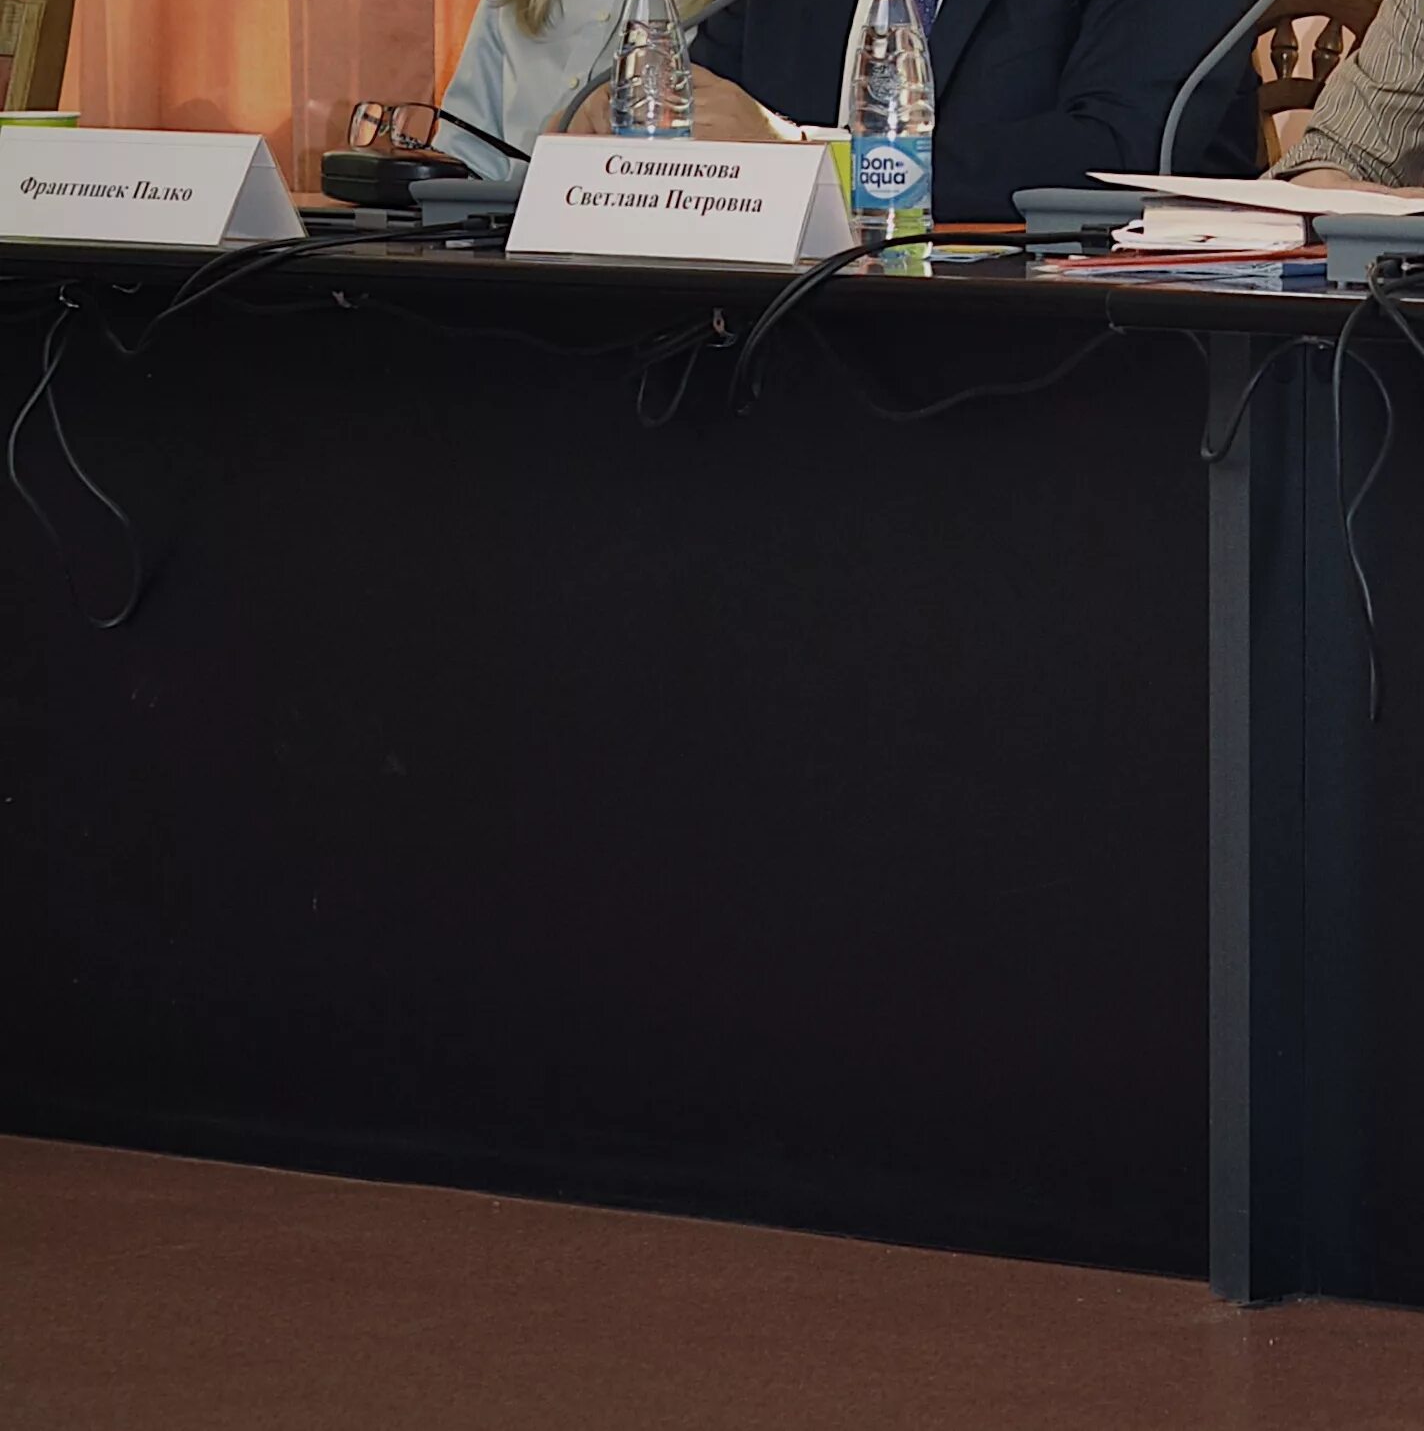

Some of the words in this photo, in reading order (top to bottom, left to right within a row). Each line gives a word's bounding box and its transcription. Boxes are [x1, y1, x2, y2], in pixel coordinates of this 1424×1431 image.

[860, 153, 894, 171] bon
[20, 176, 129, 200] Франтишек
[132, 180, 193, 202] Палко
[860, 172, 905, 189] aqua
[565, 185, 660, 209] Светлана
[664, 189, 763, 217] Петровна
